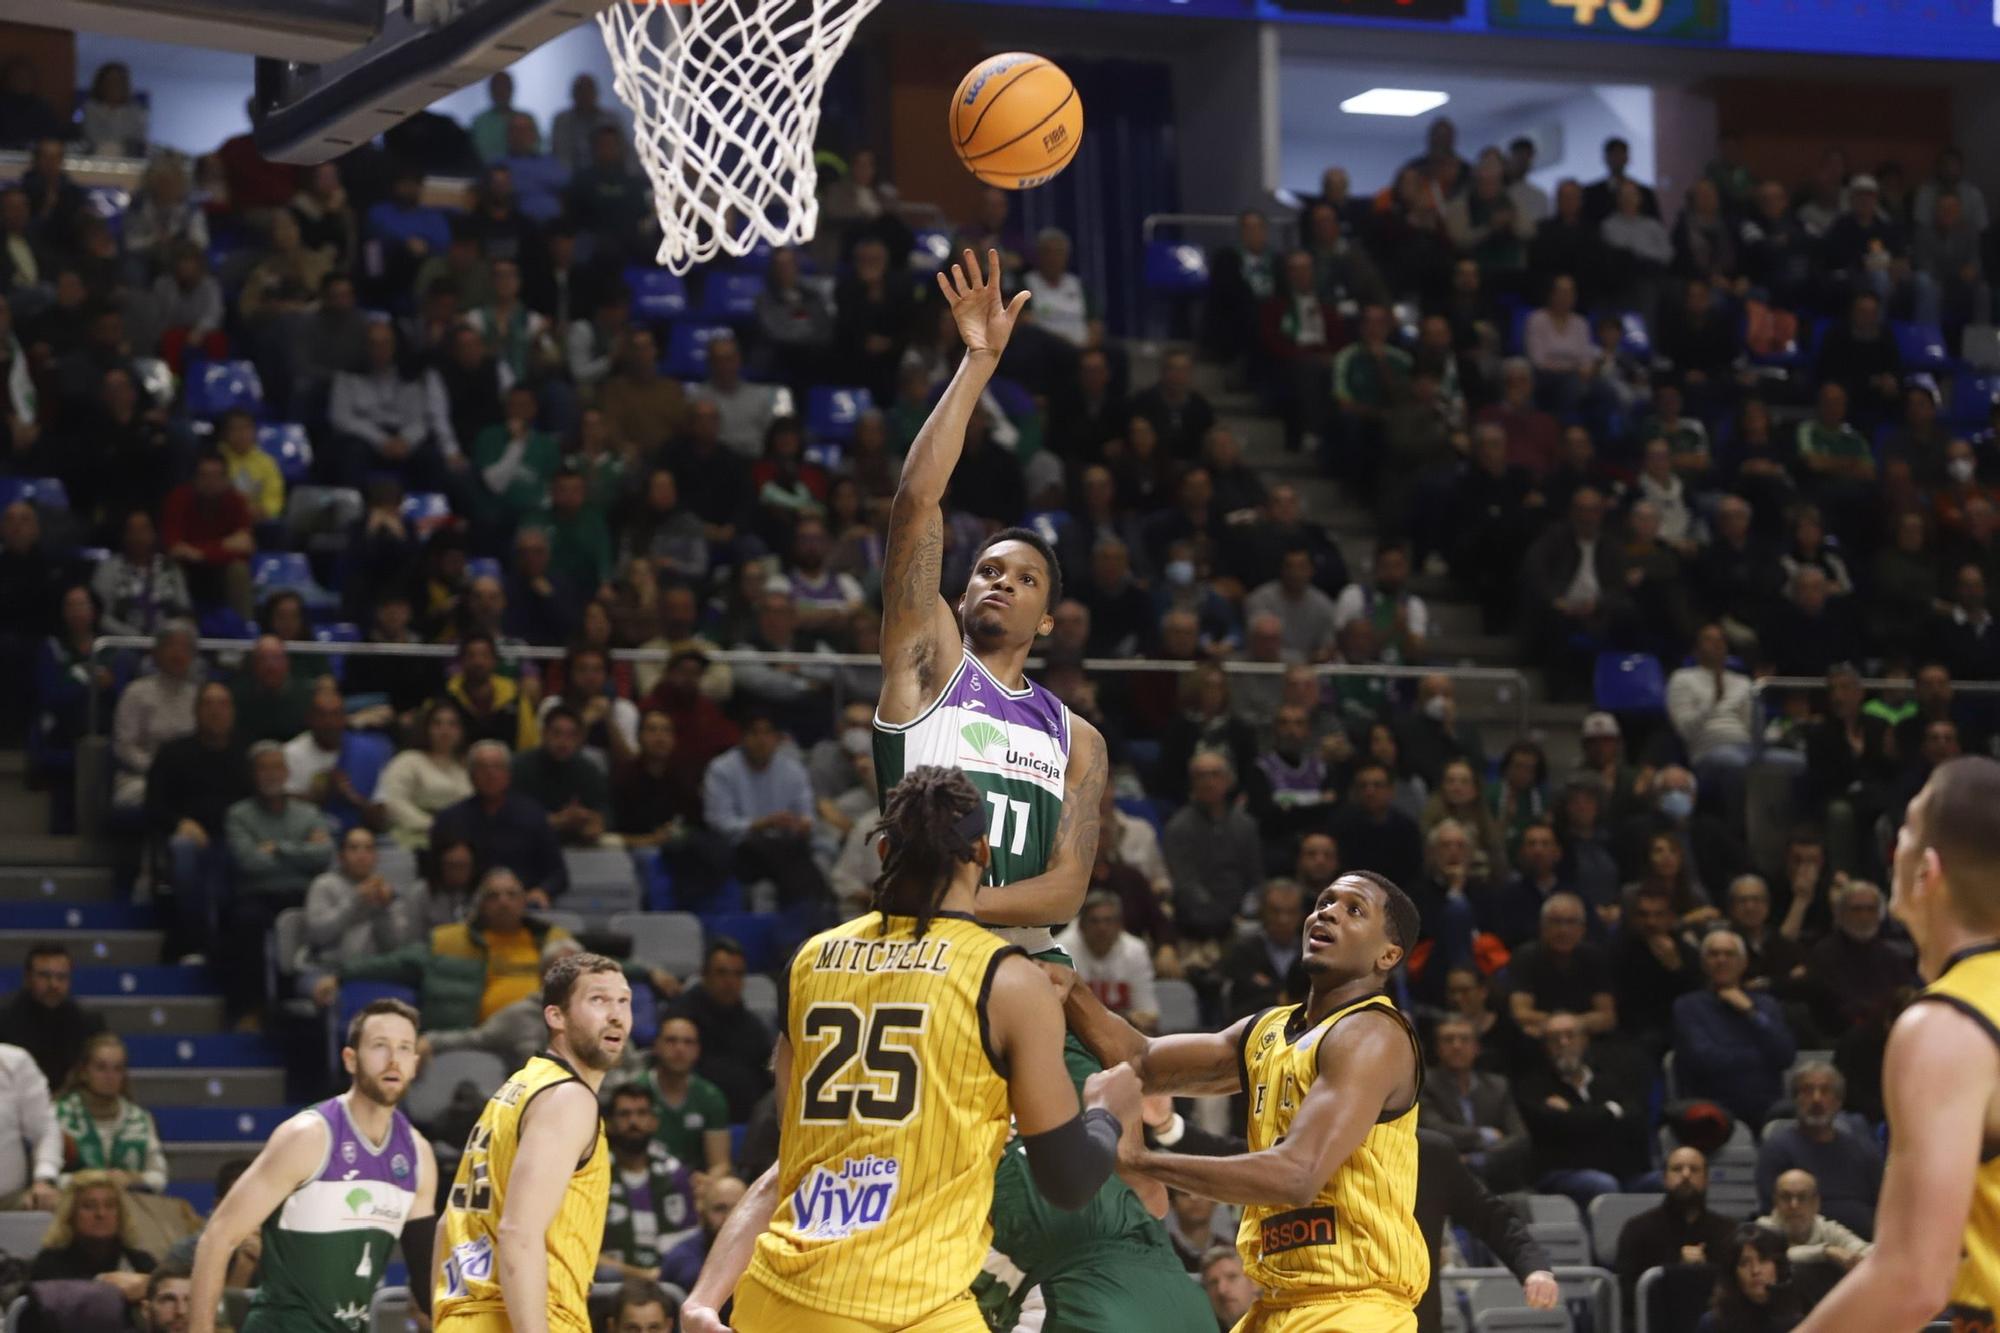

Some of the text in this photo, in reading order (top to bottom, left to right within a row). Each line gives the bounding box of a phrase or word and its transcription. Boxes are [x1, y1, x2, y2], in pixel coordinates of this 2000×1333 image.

[1006, 750, 1060, 779] Unicaja
[986, 791, 1031, 856] 11
[814, 938, 948, 972] MITCHELL
[801, 1003, 928, 1124] 25
[839, 1157, 897, 1179] Juice
[794, 1172, 893, 1230] Viva
